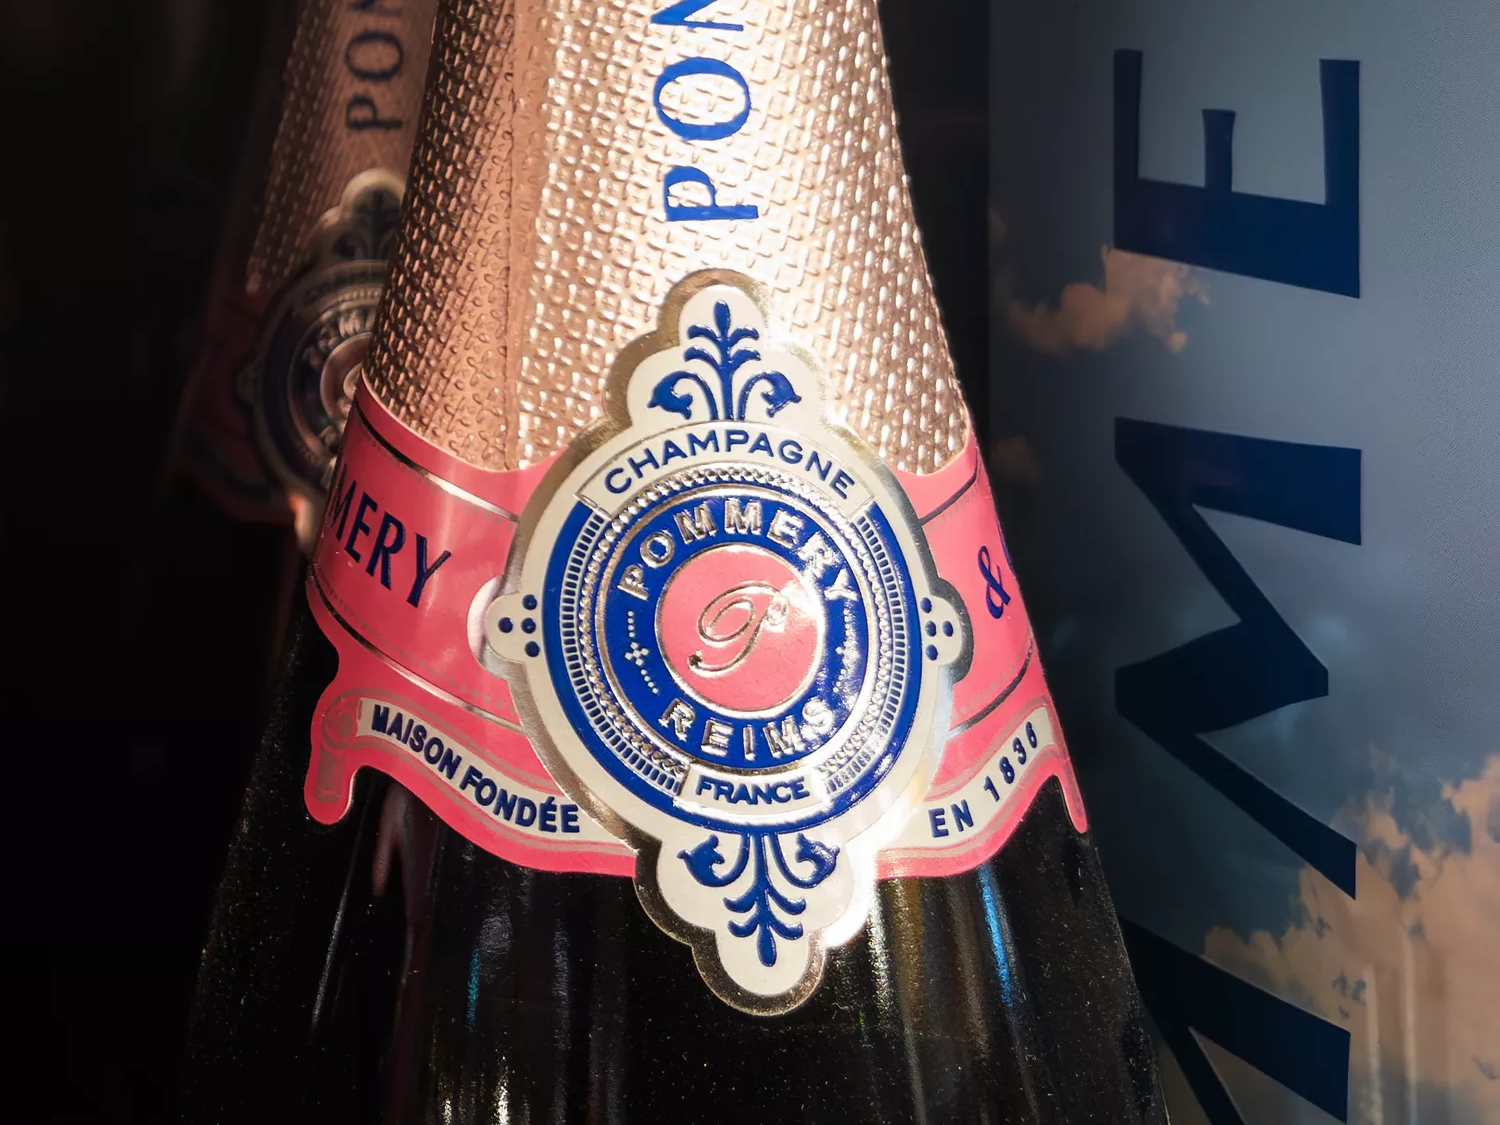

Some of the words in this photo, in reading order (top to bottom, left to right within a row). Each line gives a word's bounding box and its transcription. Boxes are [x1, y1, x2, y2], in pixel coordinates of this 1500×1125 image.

[604, 429, 856, 500] CHAMPAGNE
[617, 497, 859, 602] POMMERY
[976, 545, 1011, 620] &
[658, 696, 836, 761] REIMS
[370, 703, 463, 781] MAISON
[459, 764, 581, 834] FONDÉE
[695, 776, 810, 806] FRANCE
[928, 798, 975, 839] EN
[983, 721, 1038, 803] 1836
